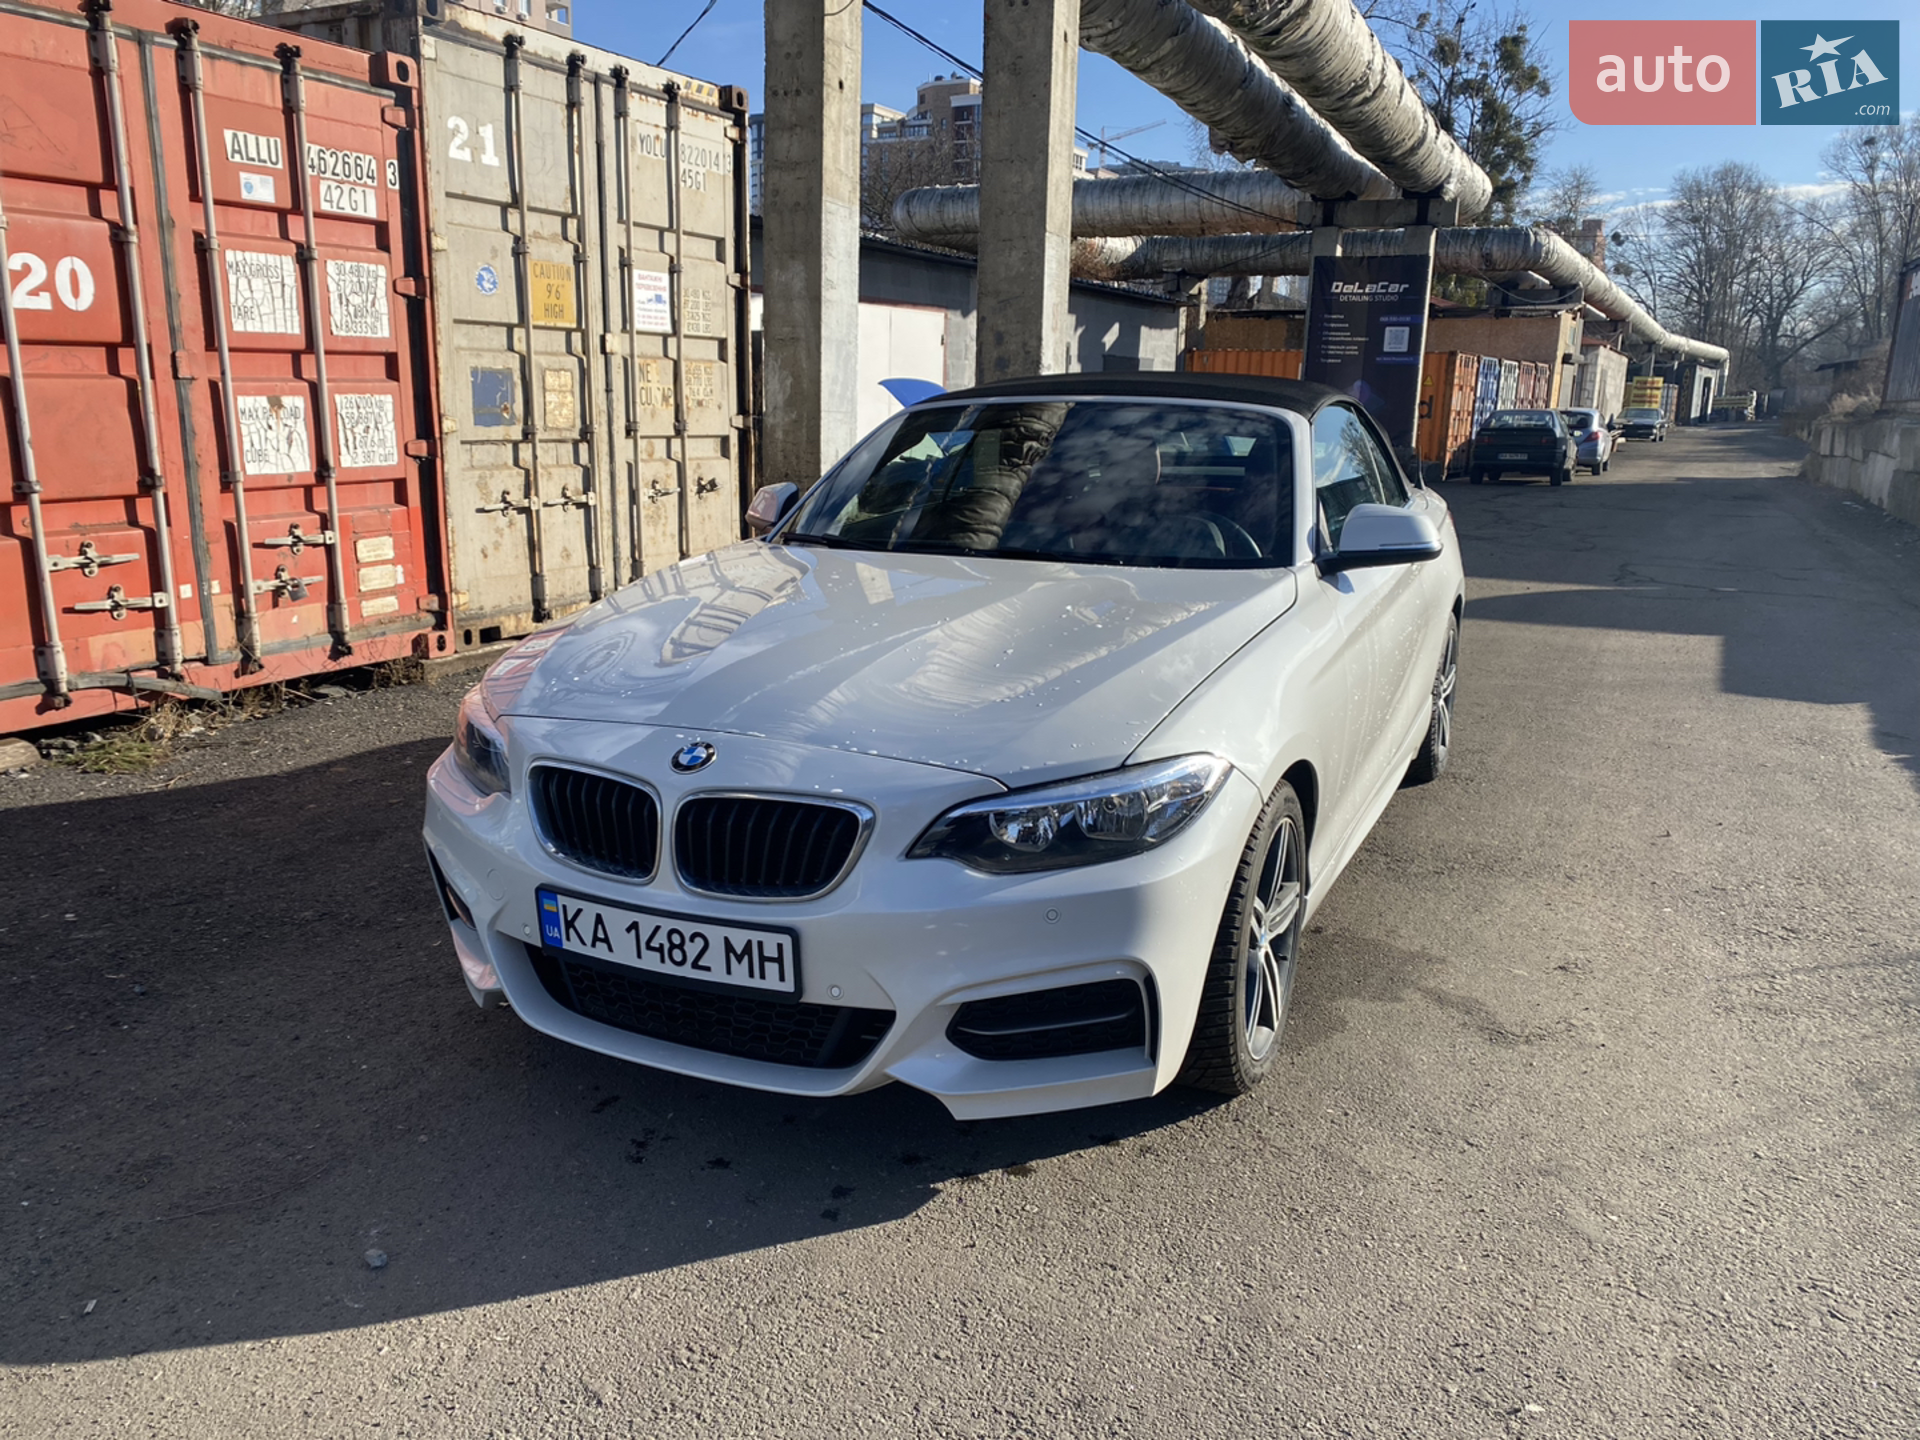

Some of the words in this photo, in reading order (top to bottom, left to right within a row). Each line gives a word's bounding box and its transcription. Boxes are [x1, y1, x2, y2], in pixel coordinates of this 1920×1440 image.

[230, 132, 280, 166] ALLU
[447, 115, 500, 167] 21
[308, 146, 377, 184] 462664
[387, 161, 397, 187] 3
[680, 143, 720, 171] 822014
[681, 168, 706, 191] 45G1
[323, 184, 368, 213] 42G1
[7, 252, 95, 312] 20
[533, 262, 571, 281] CAUTION
[232, 305, 255, 321] TARE
[543, 302, 565, 319] HIGH
[240, 407, 259, 420] MAX
[245, 450, 269, 464] CUBE
[545, 924, 561, 940] UA
[624, 920, 712, 973] 1482
